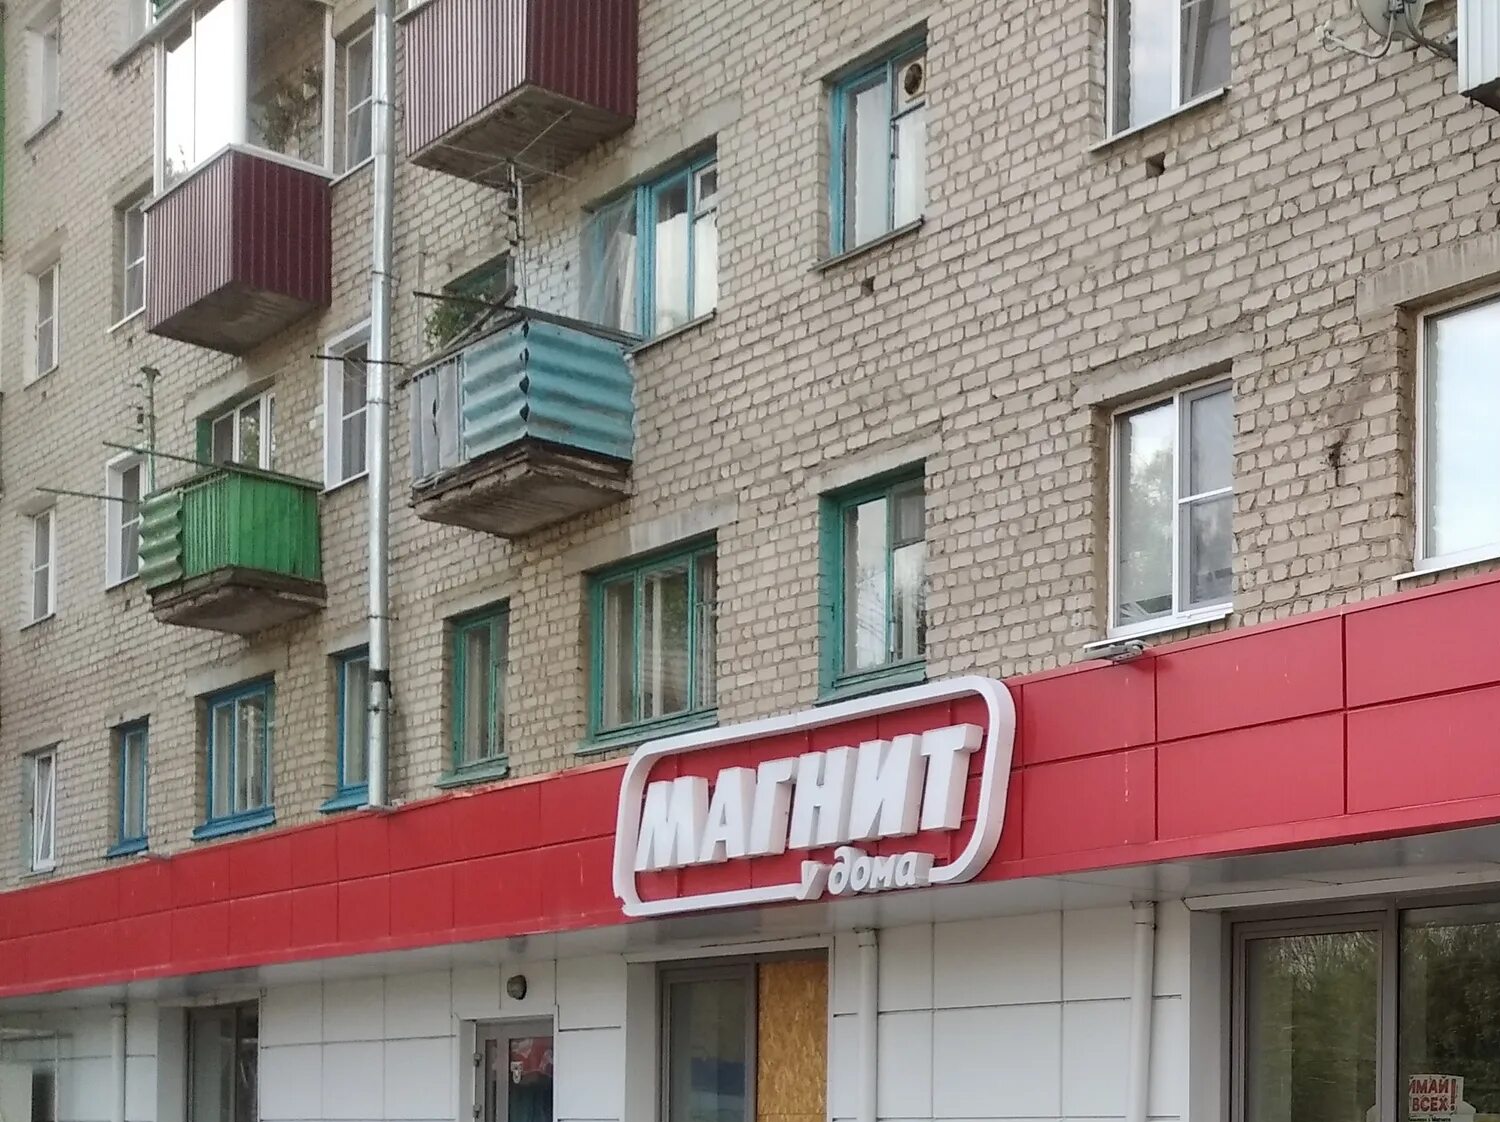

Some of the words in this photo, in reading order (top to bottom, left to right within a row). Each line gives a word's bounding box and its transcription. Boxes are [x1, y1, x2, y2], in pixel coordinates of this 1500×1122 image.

[635, 724, 983, 871] МАГНИТ
[798, 860, 831, 900] у
[828, 846, 934, 897] дома
